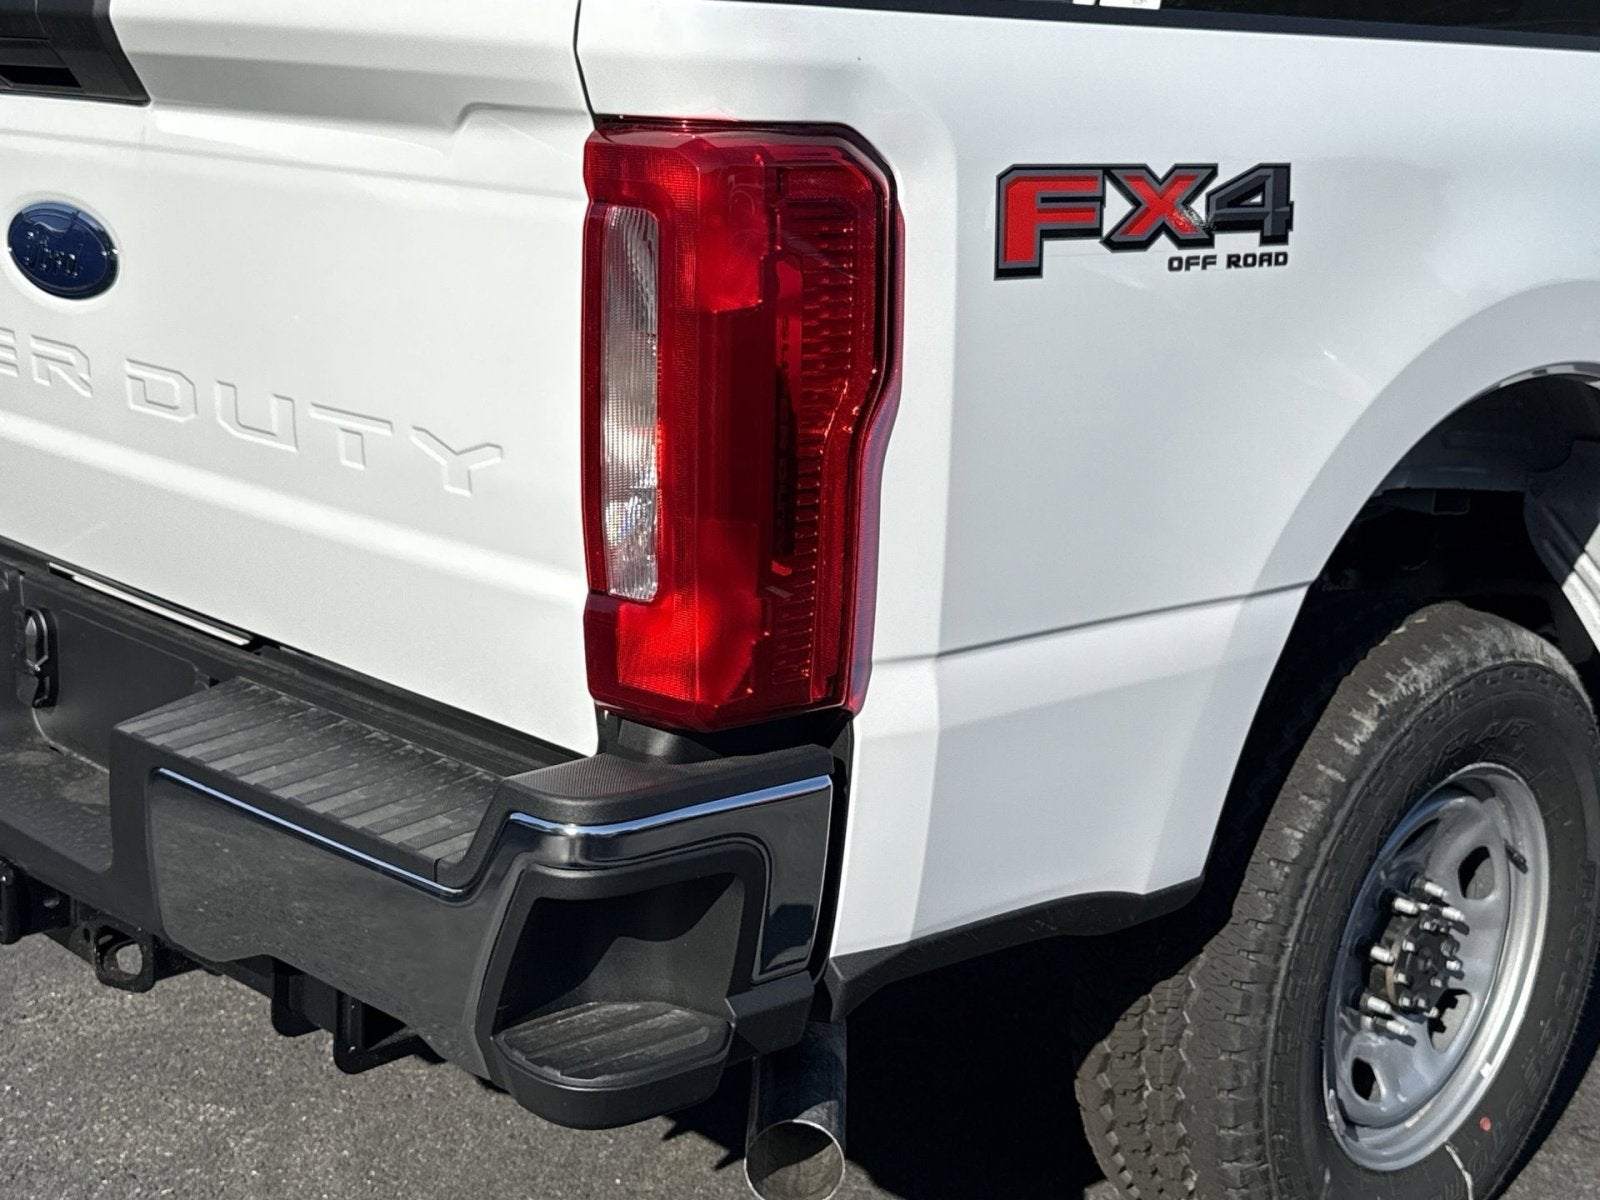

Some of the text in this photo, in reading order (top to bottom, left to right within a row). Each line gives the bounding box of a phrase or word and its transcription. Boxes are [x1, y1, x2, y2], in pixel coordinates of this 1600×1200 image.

[994, 163, 1294, 281] FX4
[1167, 251, 1289, 272] OFF ROAD
[124, 358, 503, 497] DUTY
